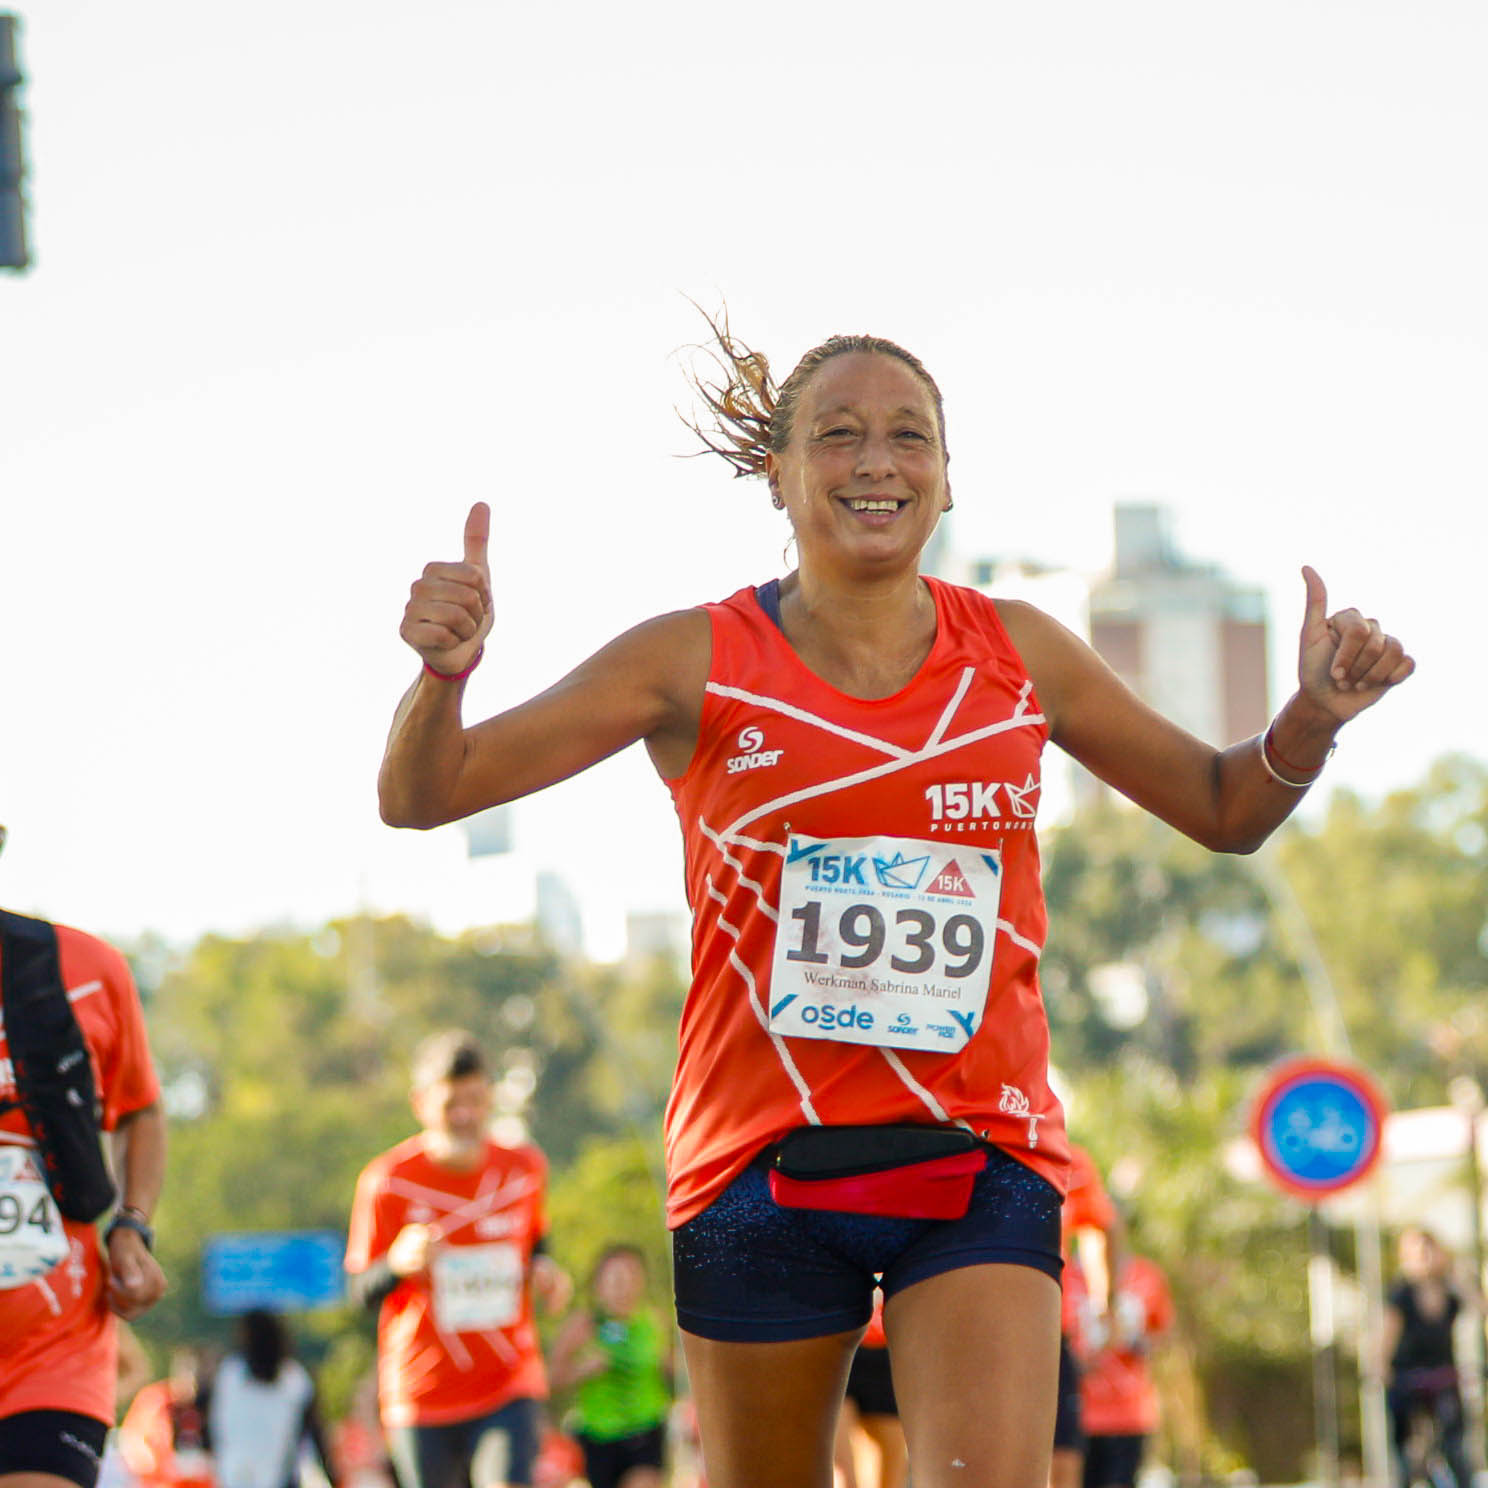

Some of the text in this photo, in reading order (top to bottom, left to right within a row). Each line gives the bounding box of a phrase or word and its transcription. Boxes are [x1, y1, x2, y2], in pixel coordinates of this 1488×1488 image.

[925, 782, 1002, 820] 15K
[808, 855, 867, 885] 15K
[937, 873, 966, 892] 15K
[786, 900, 985, 979] 1939
[804, 971, 962, 1000] Werkman Sabrina Mariel
[801, 1005, 874, 1030] osde
